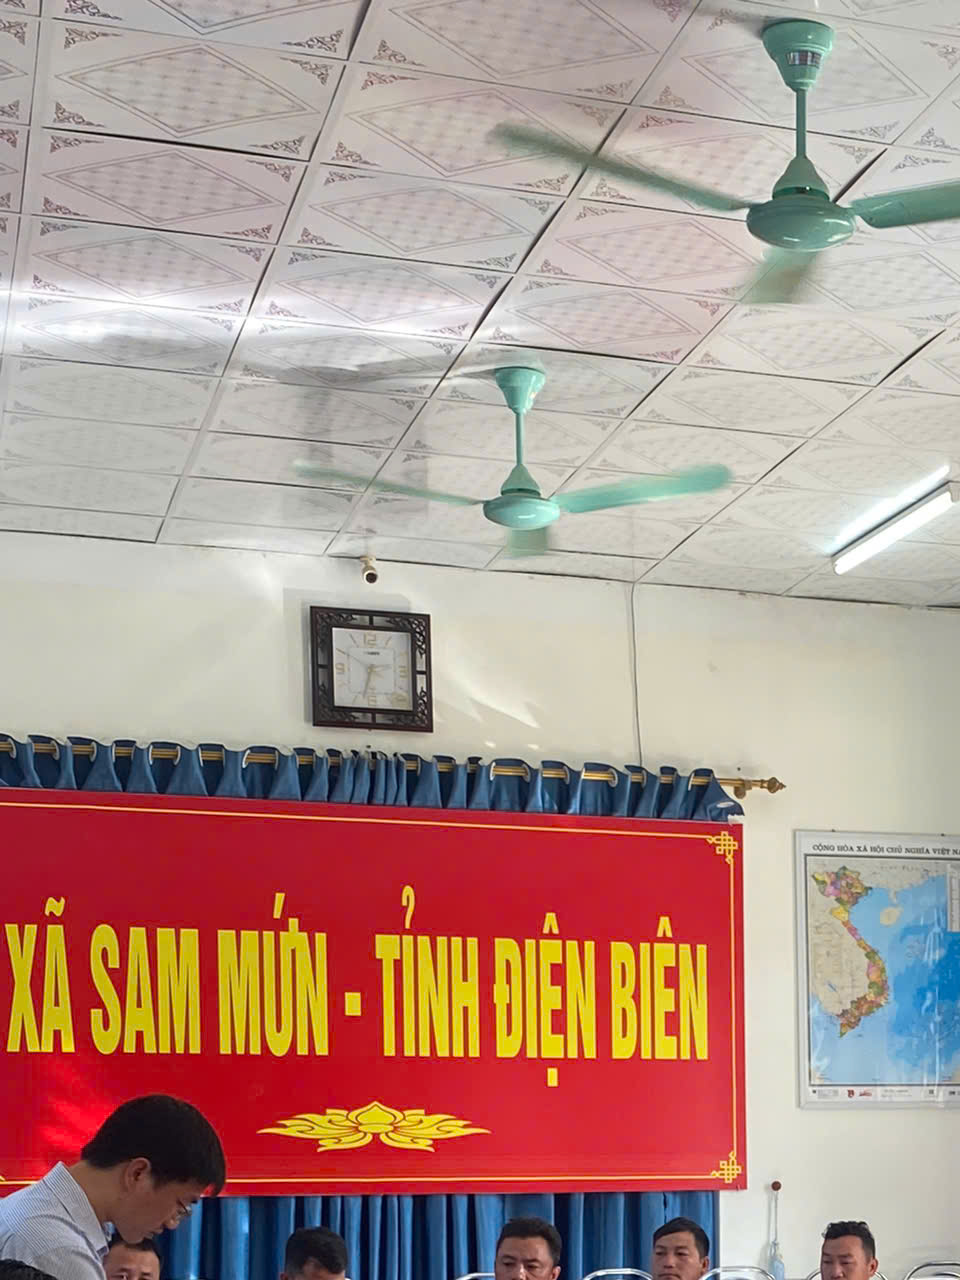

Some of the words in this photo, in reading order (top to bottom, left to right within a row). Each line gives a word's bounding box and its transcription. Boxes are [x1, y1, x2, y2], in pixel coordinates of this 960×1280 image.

[812, 843, 836, 852] CỘNG
[5, 897, 75, 1053] XÃ
[90, 924, 201, 1055] SAM
[218, 892, 329, 1057] MỨN
[375, 885, 480, 1058] TỈNH
[493, 912, 597, 1087] ĐIỆN
[610, 916, 709, 1060] BIÊN
